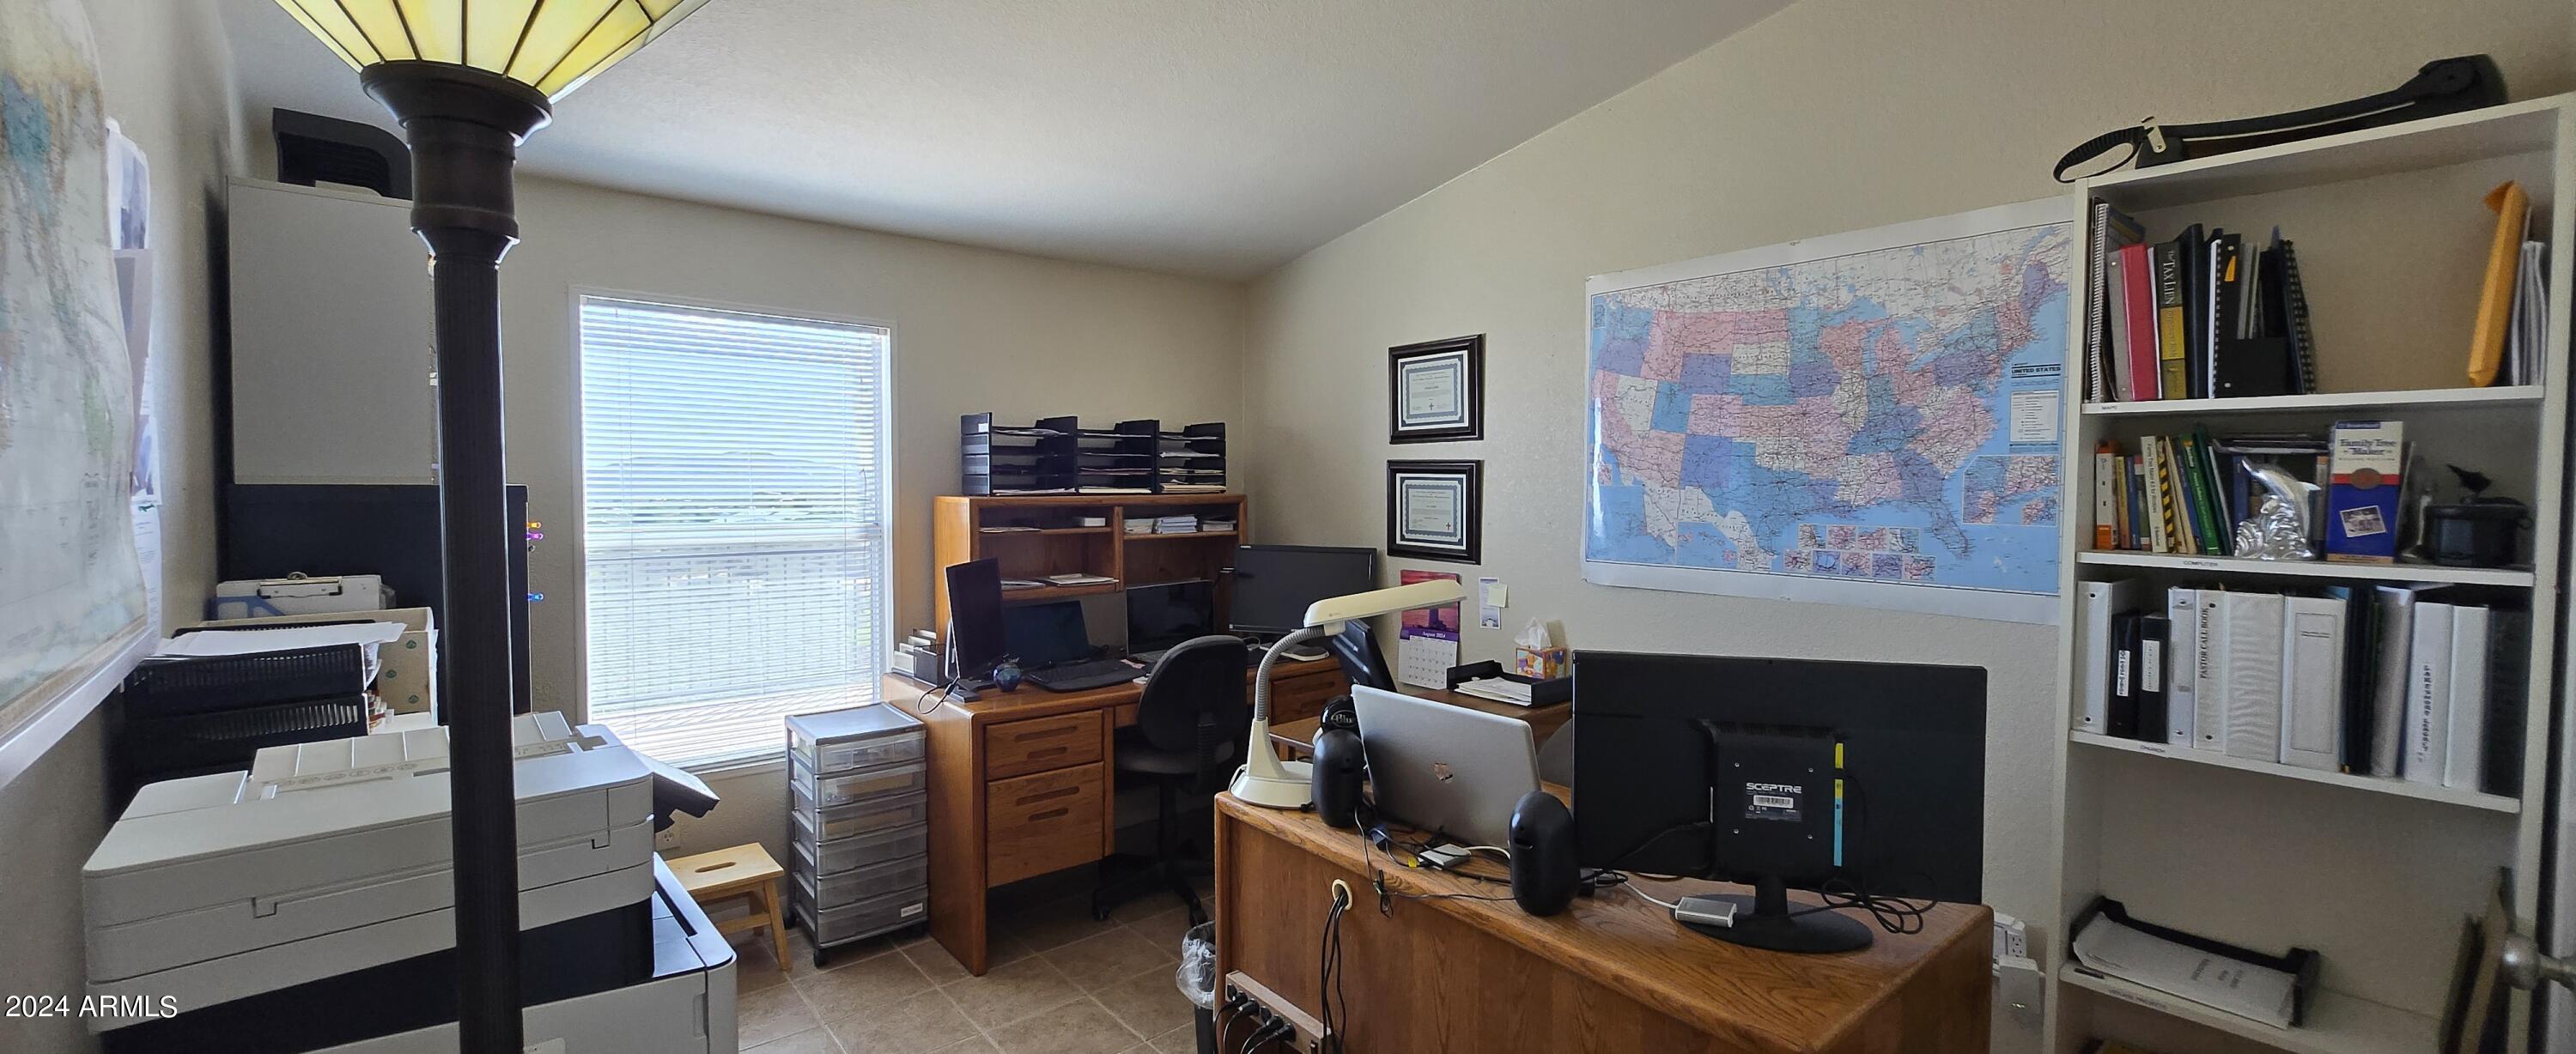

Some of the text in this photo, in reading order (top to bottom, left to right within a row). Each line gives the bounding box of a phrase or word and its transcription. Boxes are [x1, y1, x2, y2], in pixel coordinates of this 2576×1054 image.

[2163, 259, 2176, 281] TAX
[2164, 282, 2177, 305] LIEN
[2340, 439, 2372, 447] Family
[2348, 447, 2385, 456] Maker
[2199, 607, 2209, 679] PASTOR CALL BOOK
[1746, 782, 1802, 794] SCEPTRE
